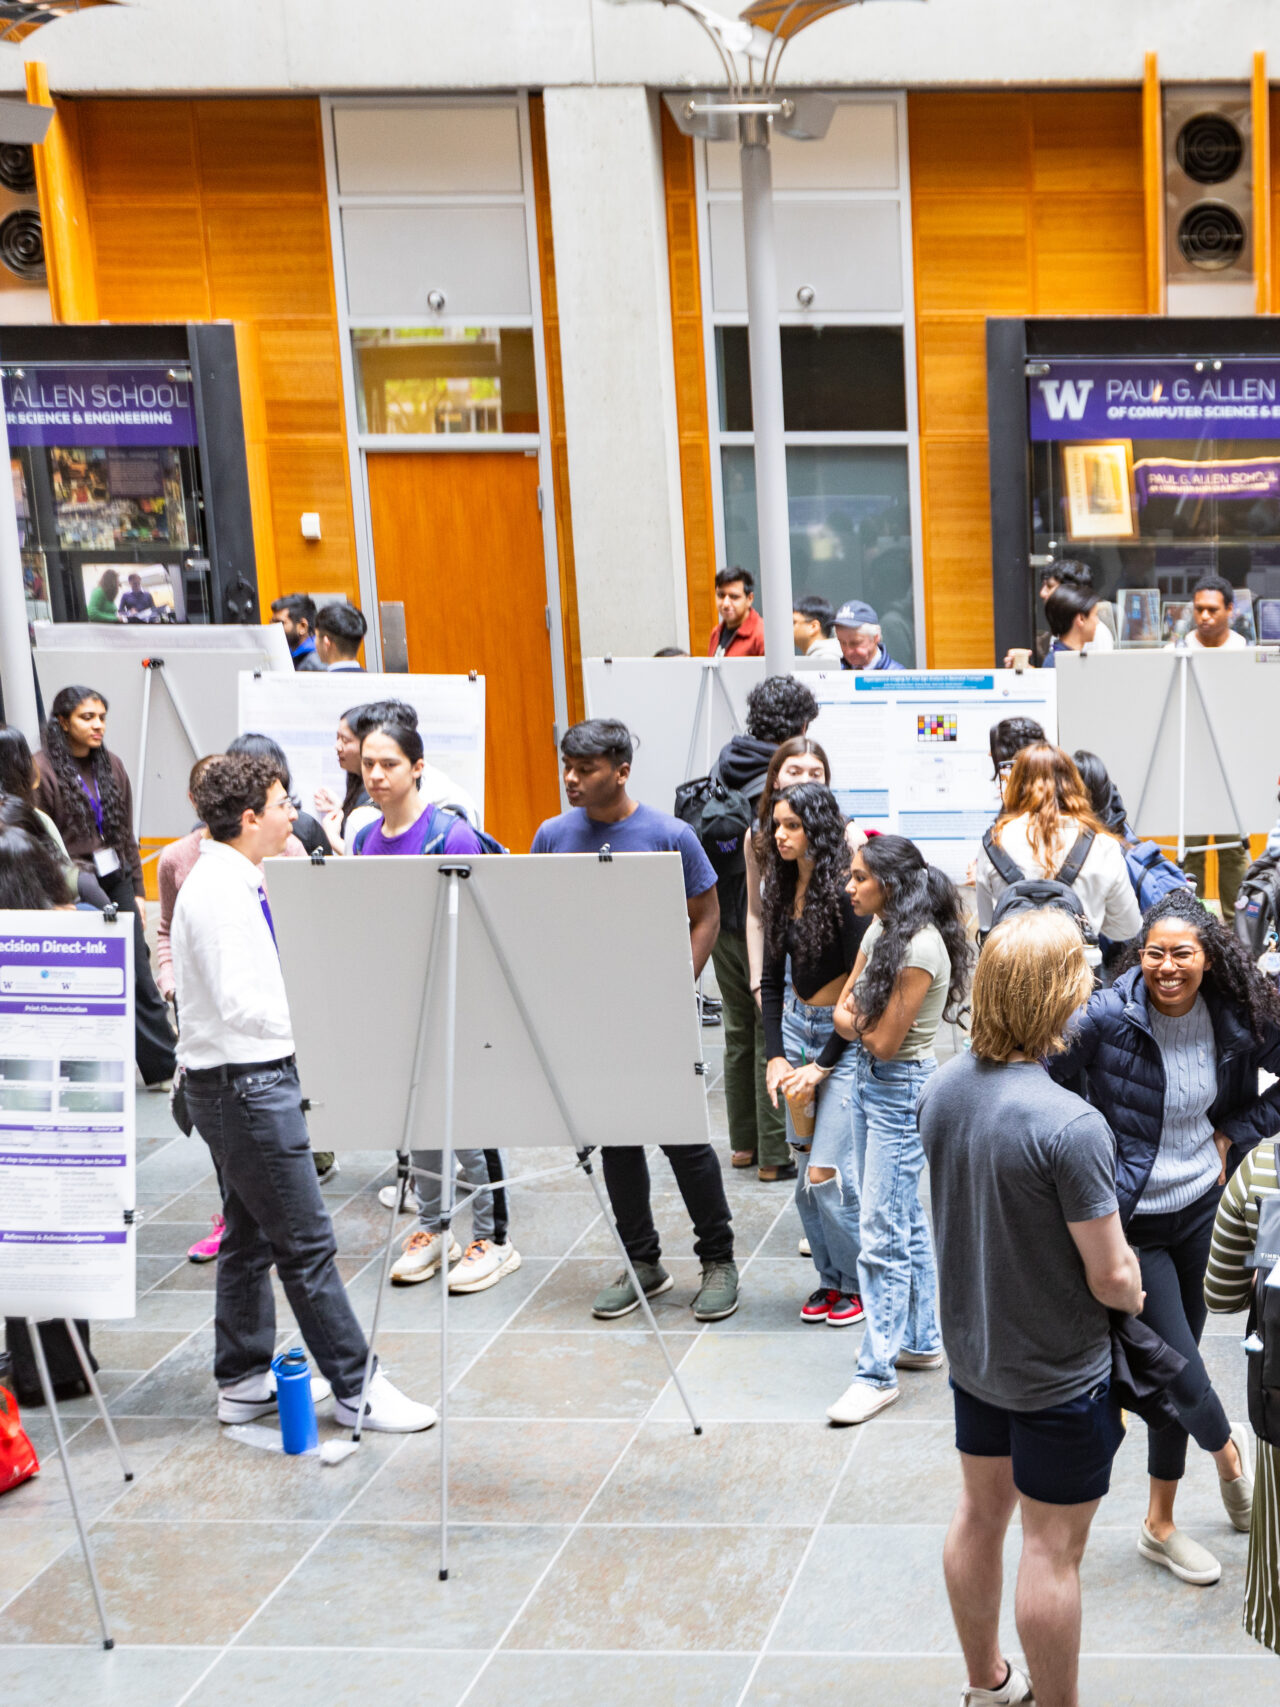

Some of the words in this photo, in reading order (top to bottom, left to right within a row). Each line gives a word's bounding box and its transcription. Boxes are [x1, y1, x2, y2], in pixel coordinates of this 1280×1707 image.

[12, 384, 87, 408] ALLEN
[91, 384, 190, 408] SCHOOL
[1106, 379, 1169, 402] PAUL
[1172, 379, 1195, 401] G.
[1199, 379, 1277, 401] ALLEN
[1038, 380, 1095, 421] W
[18, 410, 72, 424] SCIENCE
[72, 410, 83, 424] &
[84, 410, 173, 425] ENGINEERING
[1107, 405, 1128, 420] OF
[1128, 405, 1203, 420] COMPUTER
[1204, 405, 1259, 419] SCIENCE
[1259, 405, 1271, 418] &
[1150, 472, 1178, 485] PAUL
[1193, 471, 1230, 485] ALLEN
[1231, 470, 1279, 484] SCHOOL
[42, 940, 107, 954] Direct-Ink
